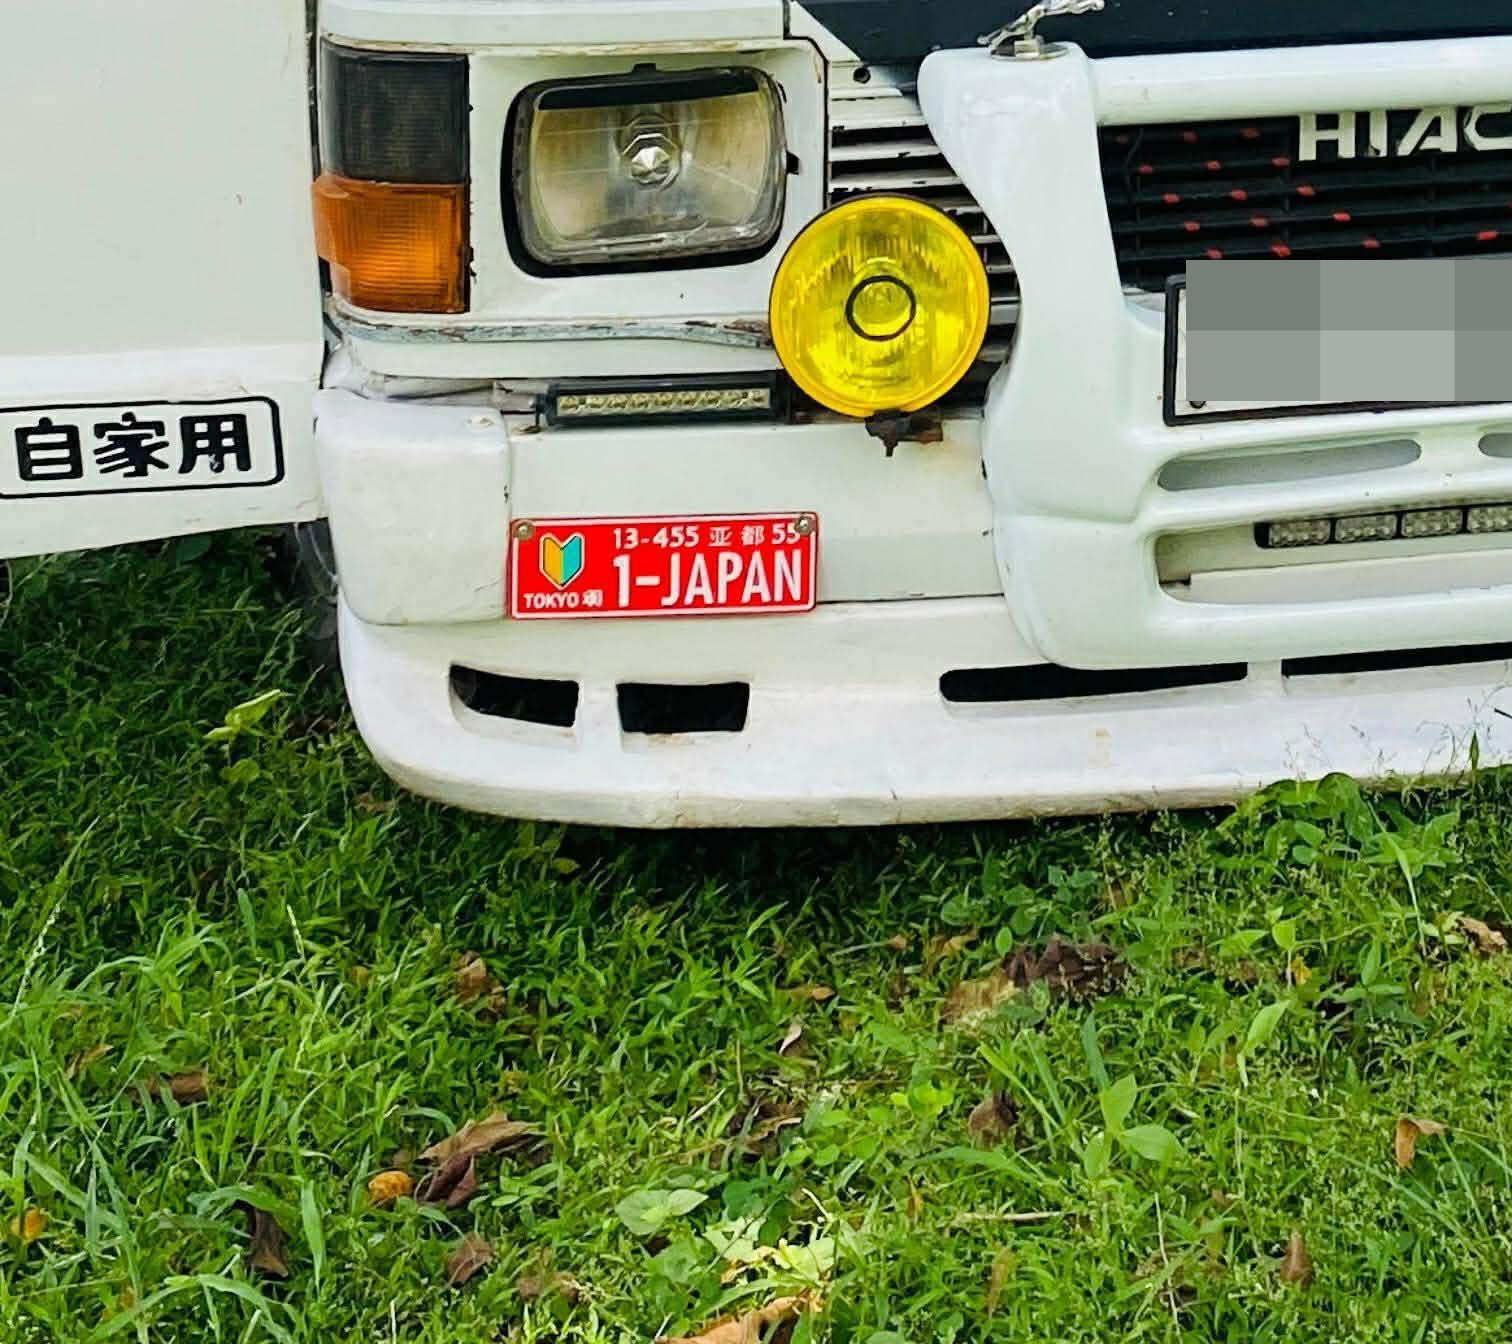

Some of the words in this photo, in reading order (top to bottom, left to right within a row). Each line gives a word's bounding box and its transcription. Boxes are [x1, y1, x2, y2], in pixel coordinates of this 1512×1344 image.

[14, 412, 252, 481] 自家用
[613, 525, 699, 549] 13-455
[771, 522, 802, 545] 55
[523, 590, 579, 610] TOKYO
[612, 548, 802, 609] 1-JAPAN
